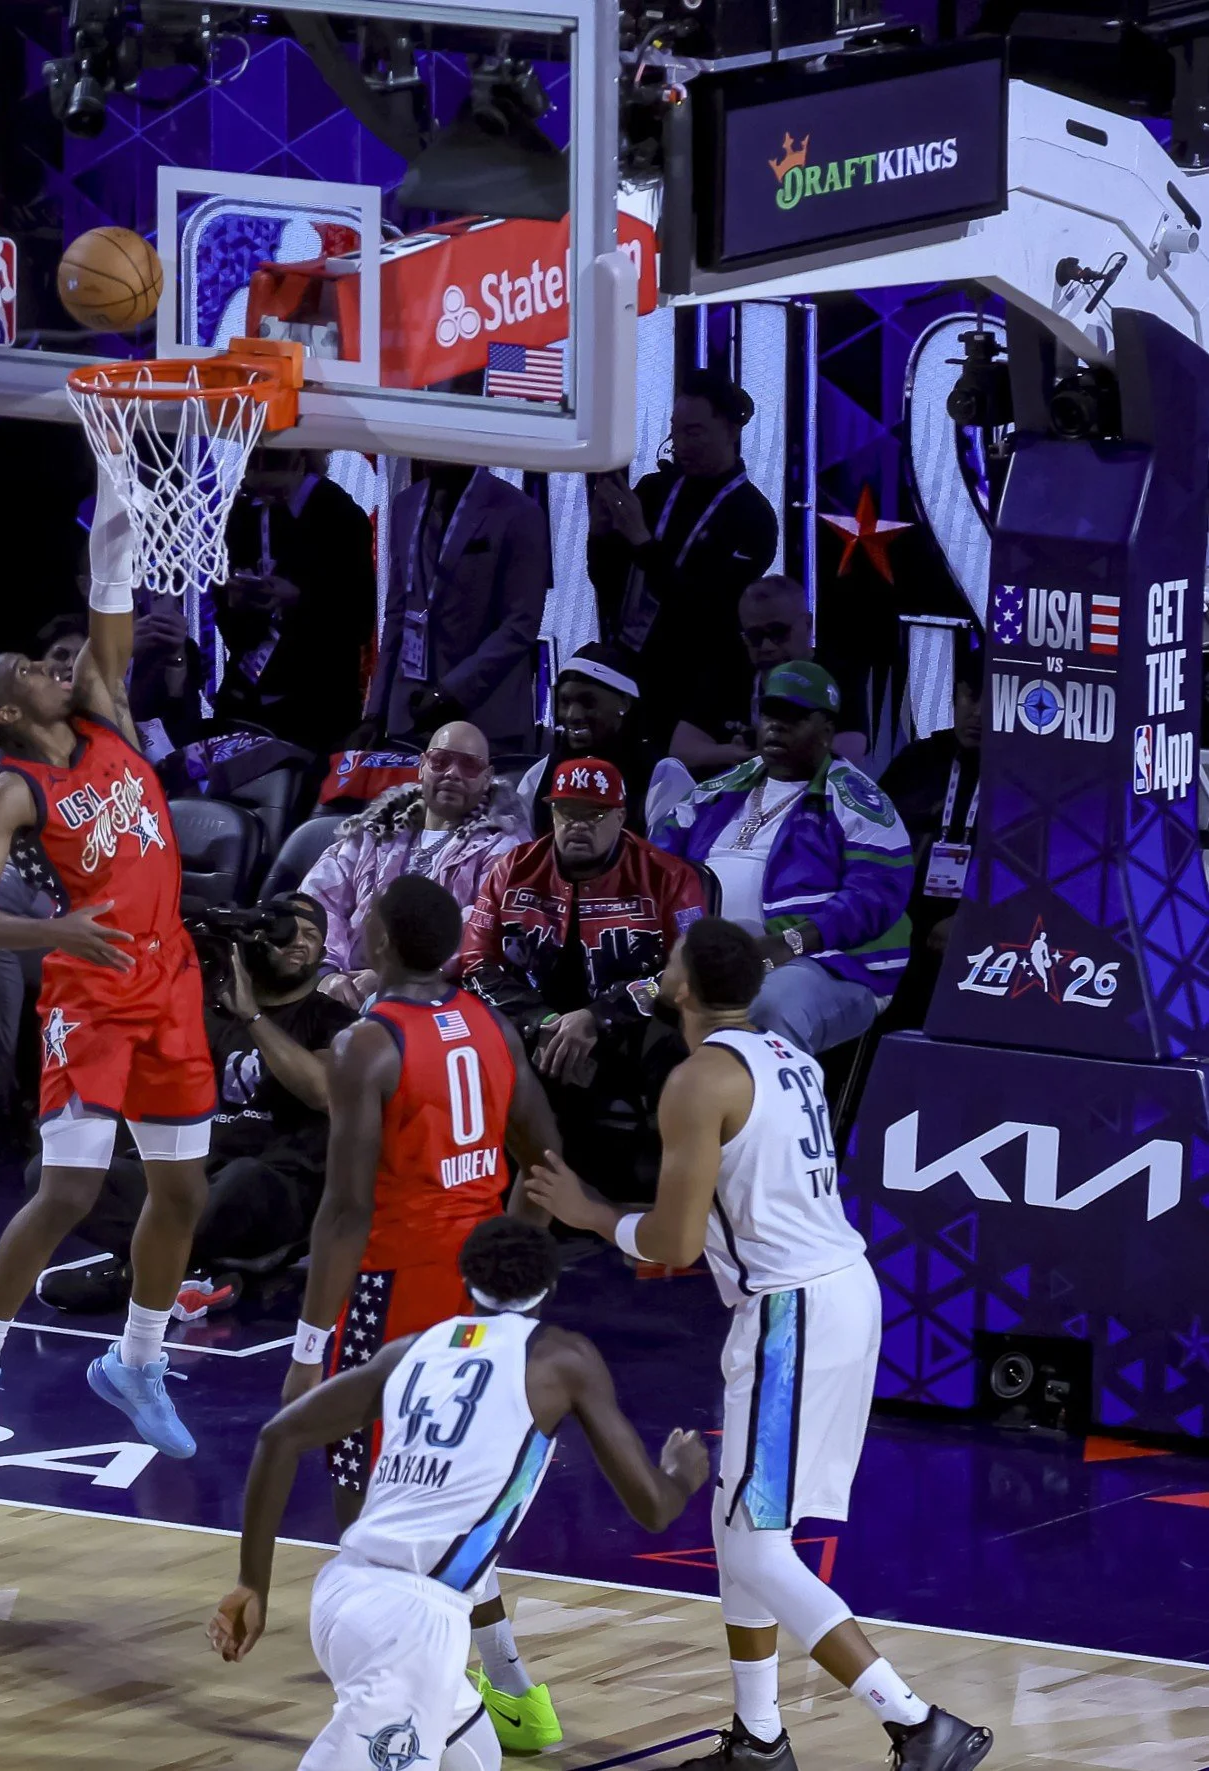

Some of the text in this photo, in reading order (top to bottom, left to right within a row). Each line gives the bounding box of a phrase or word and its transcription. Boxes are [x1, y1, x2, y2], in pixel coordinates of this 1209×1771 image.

[775, 137, 958, 210] DRAFTKINGS
[481, 259, 563, 331] State
[1027, 588, 1084, 650] USA
[1147, 579, 1188, 647] GET
[1046, 656, 1064, 673] VS
[1146, 649, 1187, 716] THE
[992, 673, 1116, 743] WORLD
[1153, 723, 1193, 800] App
[55, 782, 105, 830] USA
[957, 945, 1121, 1008] LA 26
[446, 1045, 485, 1146] 0
[778, 1065, 836, 1160] 32
[440, 1147, 498, 1190] DUREN
[883, 1110, 1183, 1221] KIA
[398, 1358, 494, 1449] 43
